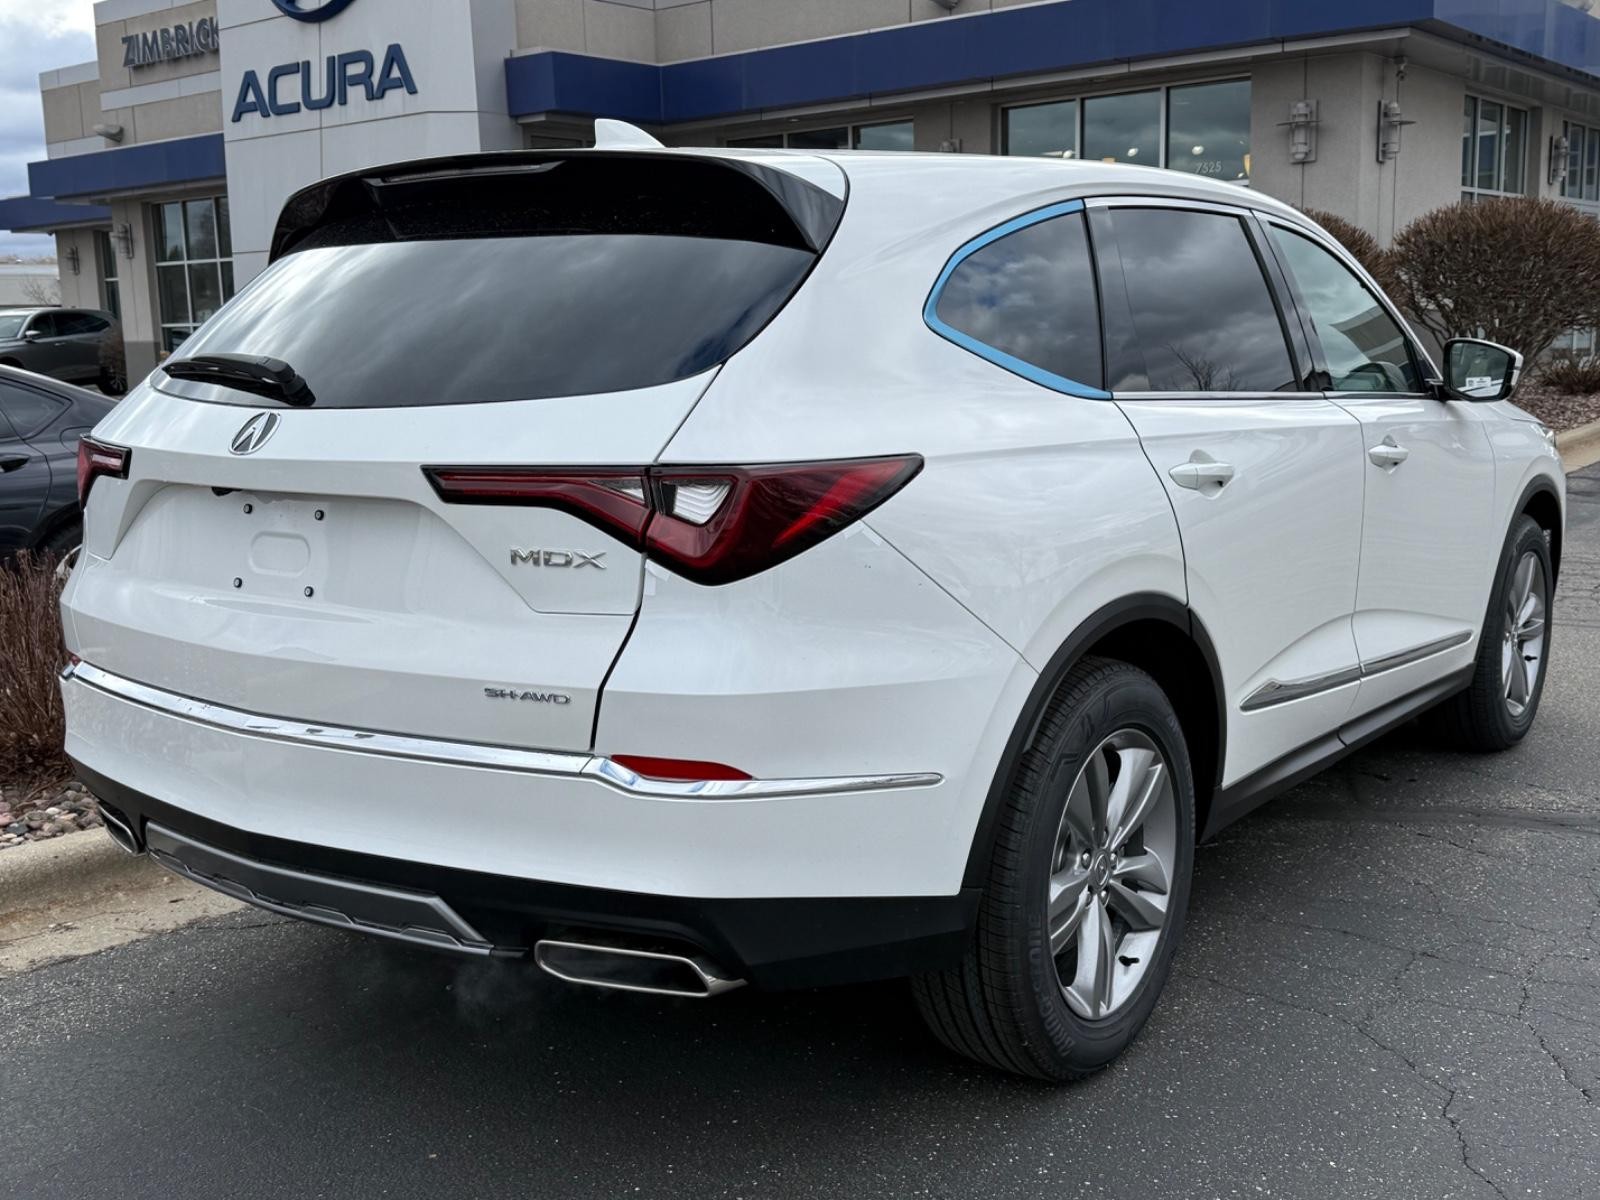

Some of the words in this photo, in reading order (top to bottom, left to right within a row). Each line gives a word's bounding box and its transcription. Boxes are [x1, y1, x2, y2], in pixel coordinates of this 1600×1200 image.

[121, 16, 219, 67] ZIMBRICK
[231, 43, 418, 123] ACURA
[1195, 161, 1222, 174] 7525
[510, 548, 607, 570] MDX
